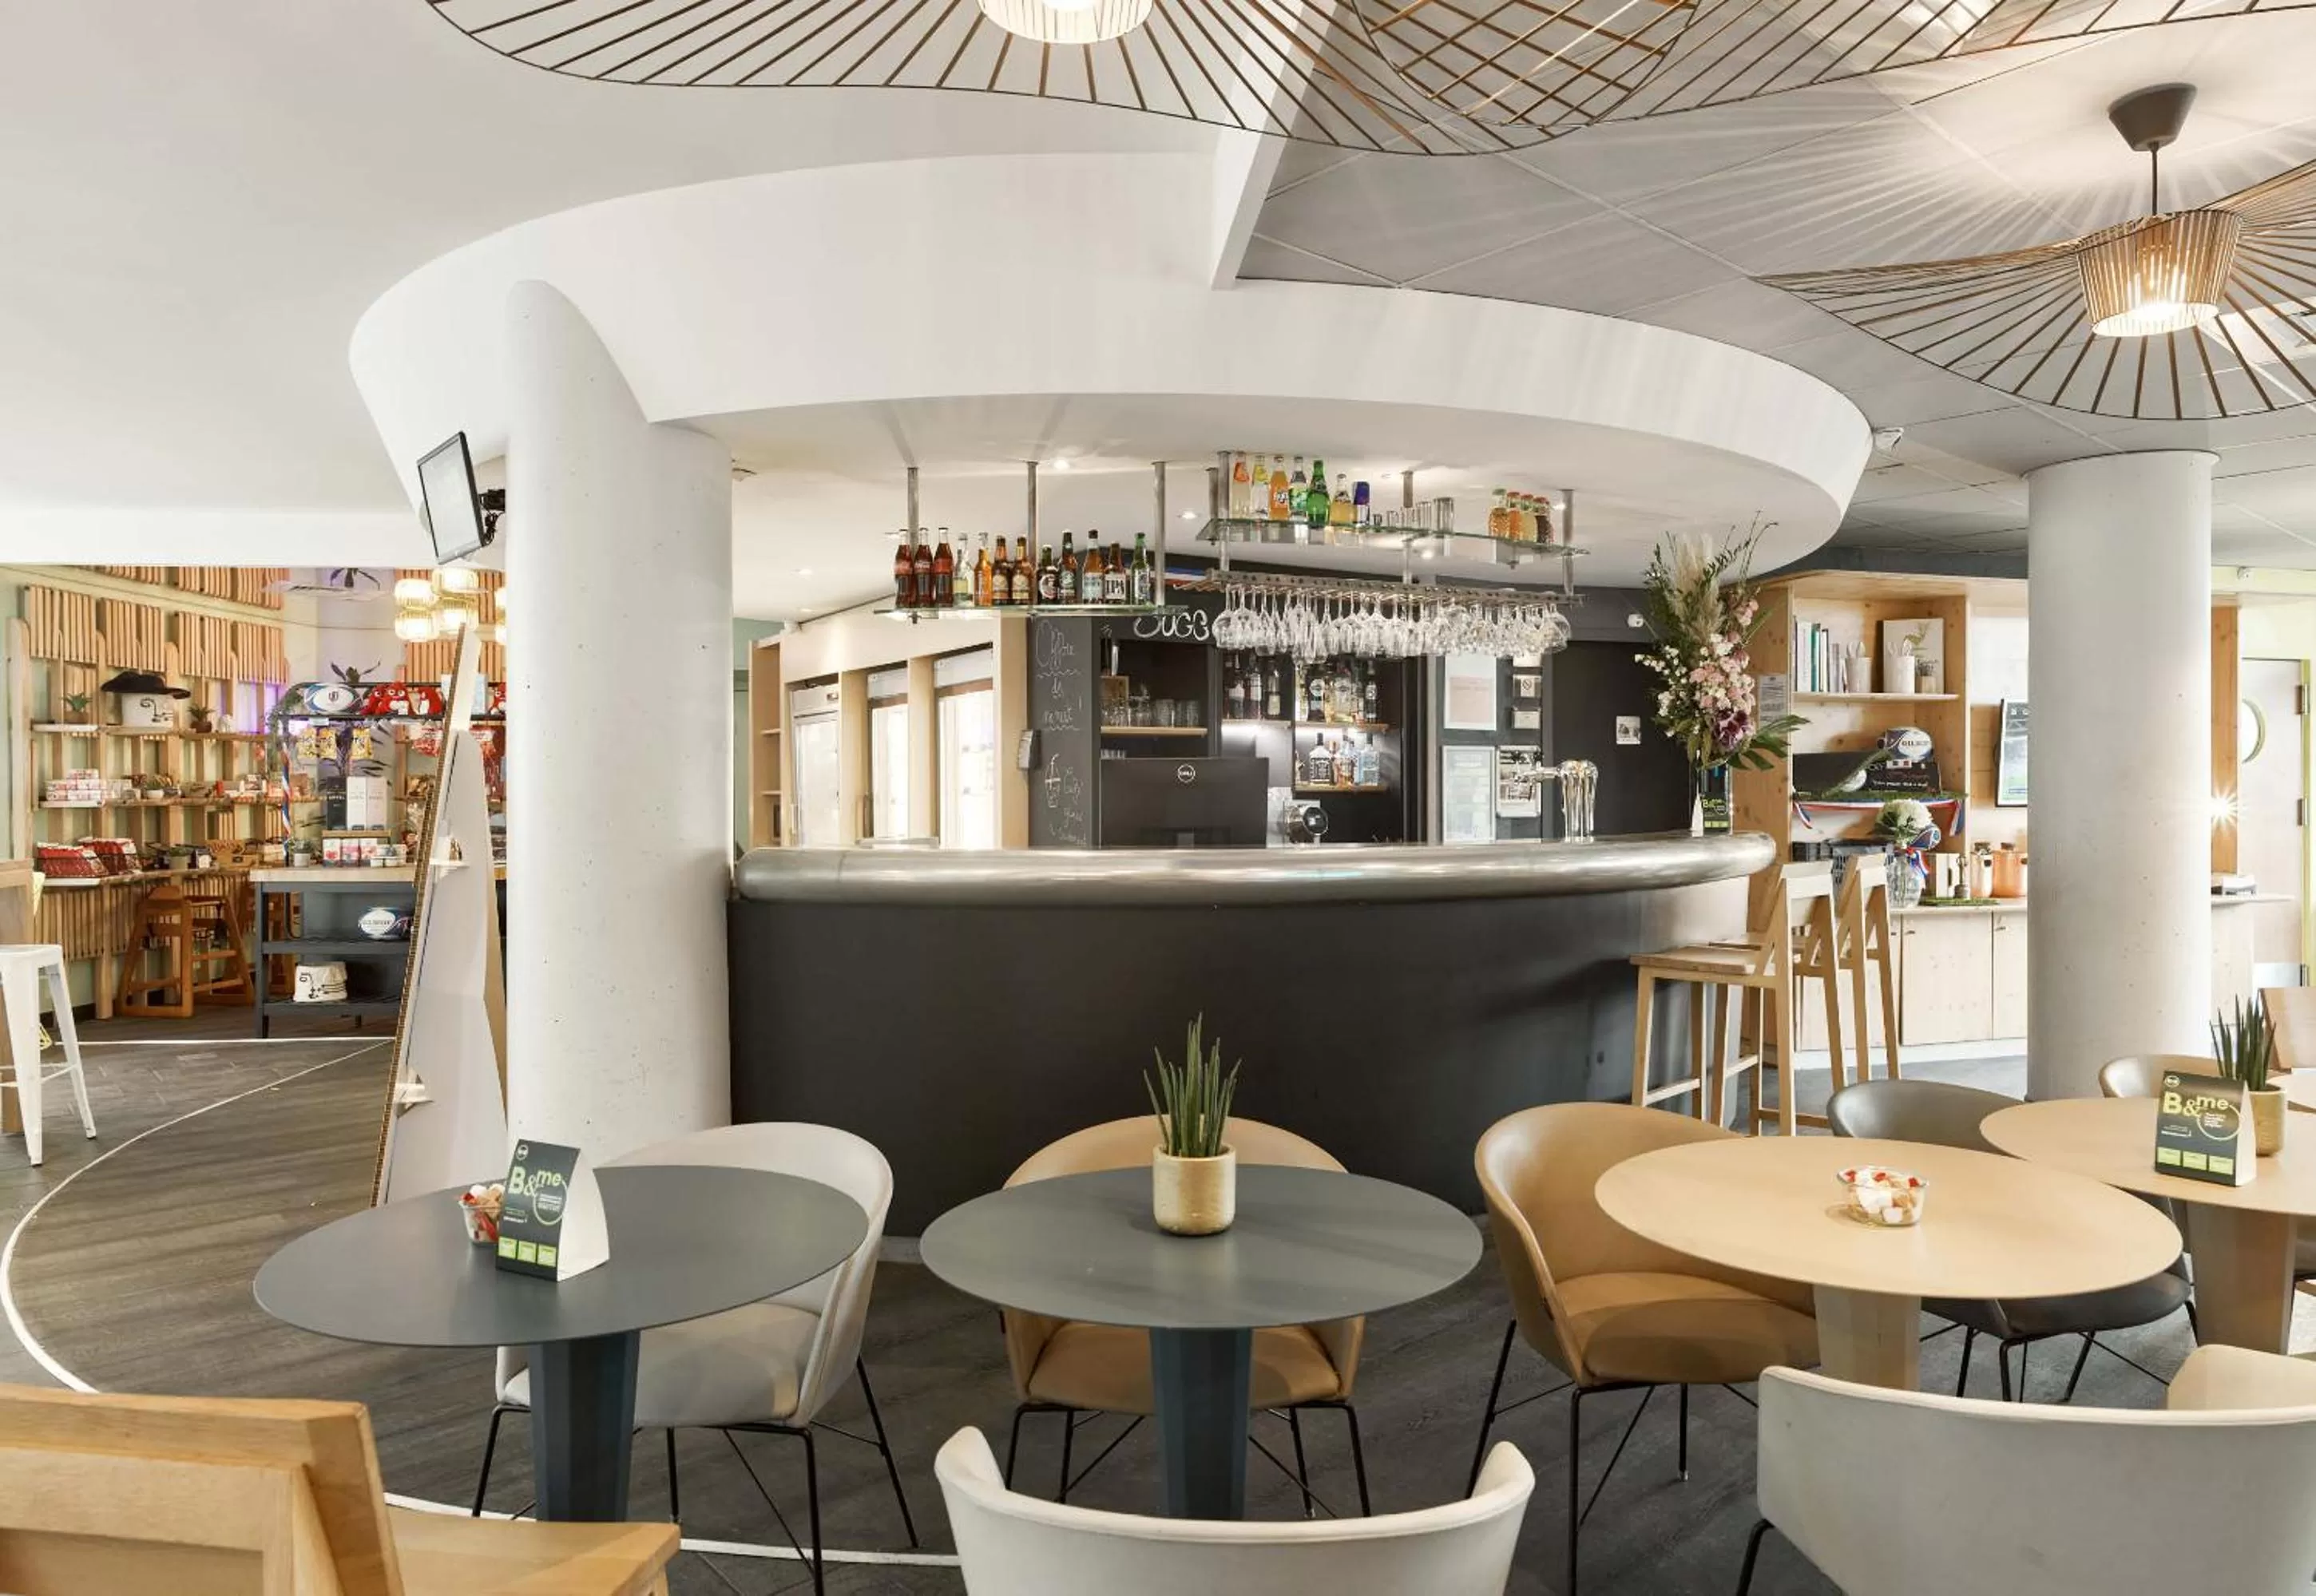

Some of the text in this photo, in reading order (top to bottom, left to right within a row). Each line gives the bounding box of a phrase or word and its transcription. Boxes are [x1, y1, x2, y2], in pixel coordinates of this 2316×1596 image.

[1104, 578, 1125, 596] IPA
[2162, 1091, 2229, 1118] B&me
[507, 1165, 562, 1197] B&me
